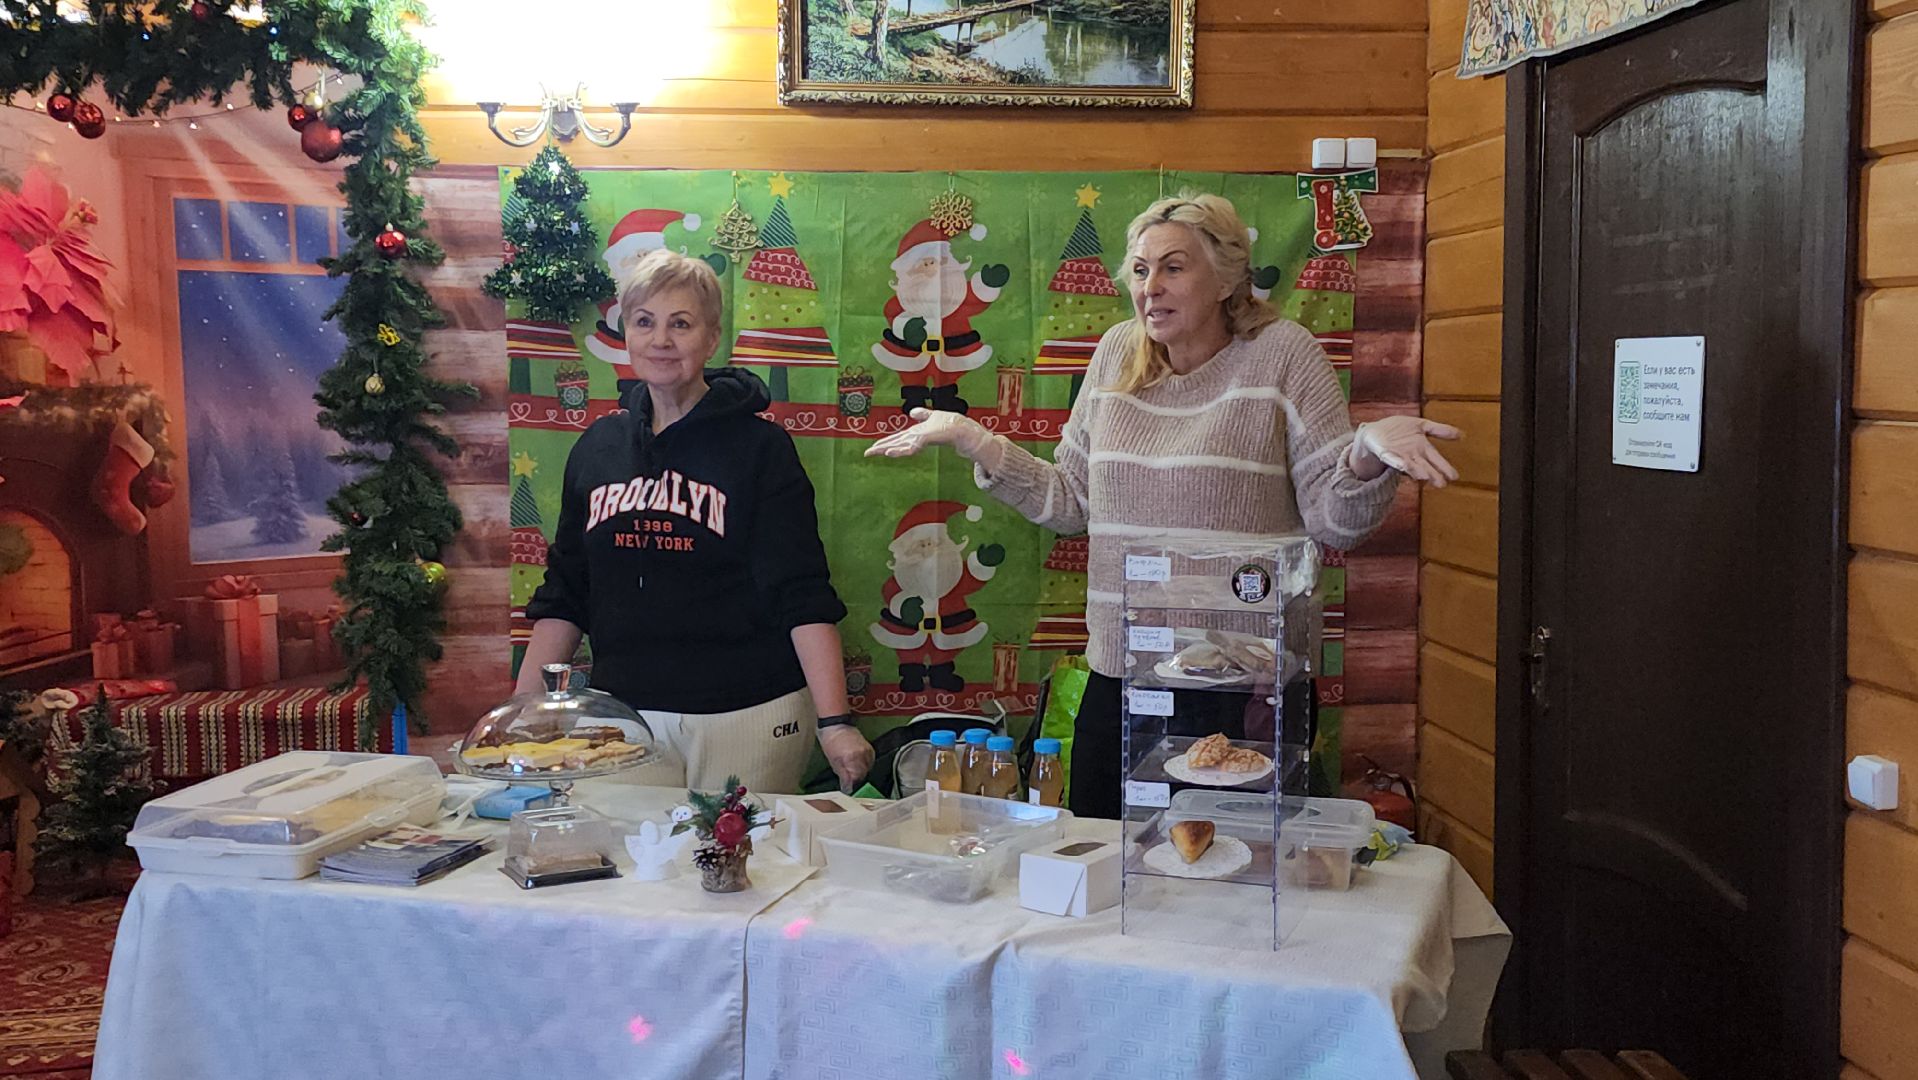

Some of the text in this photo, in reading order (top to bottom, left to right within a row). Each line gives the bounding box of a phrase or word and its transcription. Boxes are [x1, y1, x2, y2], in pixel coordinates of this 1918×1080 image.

[1644, 364, 1696, 376] Если у вас есть
[1643, 382, 1680, 391] замечания,
[1643, 395, 1684, 408] пожалуйста,
[1643, 409, 1690, 421] сообщите нам
[614, 532, 695, 552] NEW YORK
[773, 720, 800, 738] CHA
